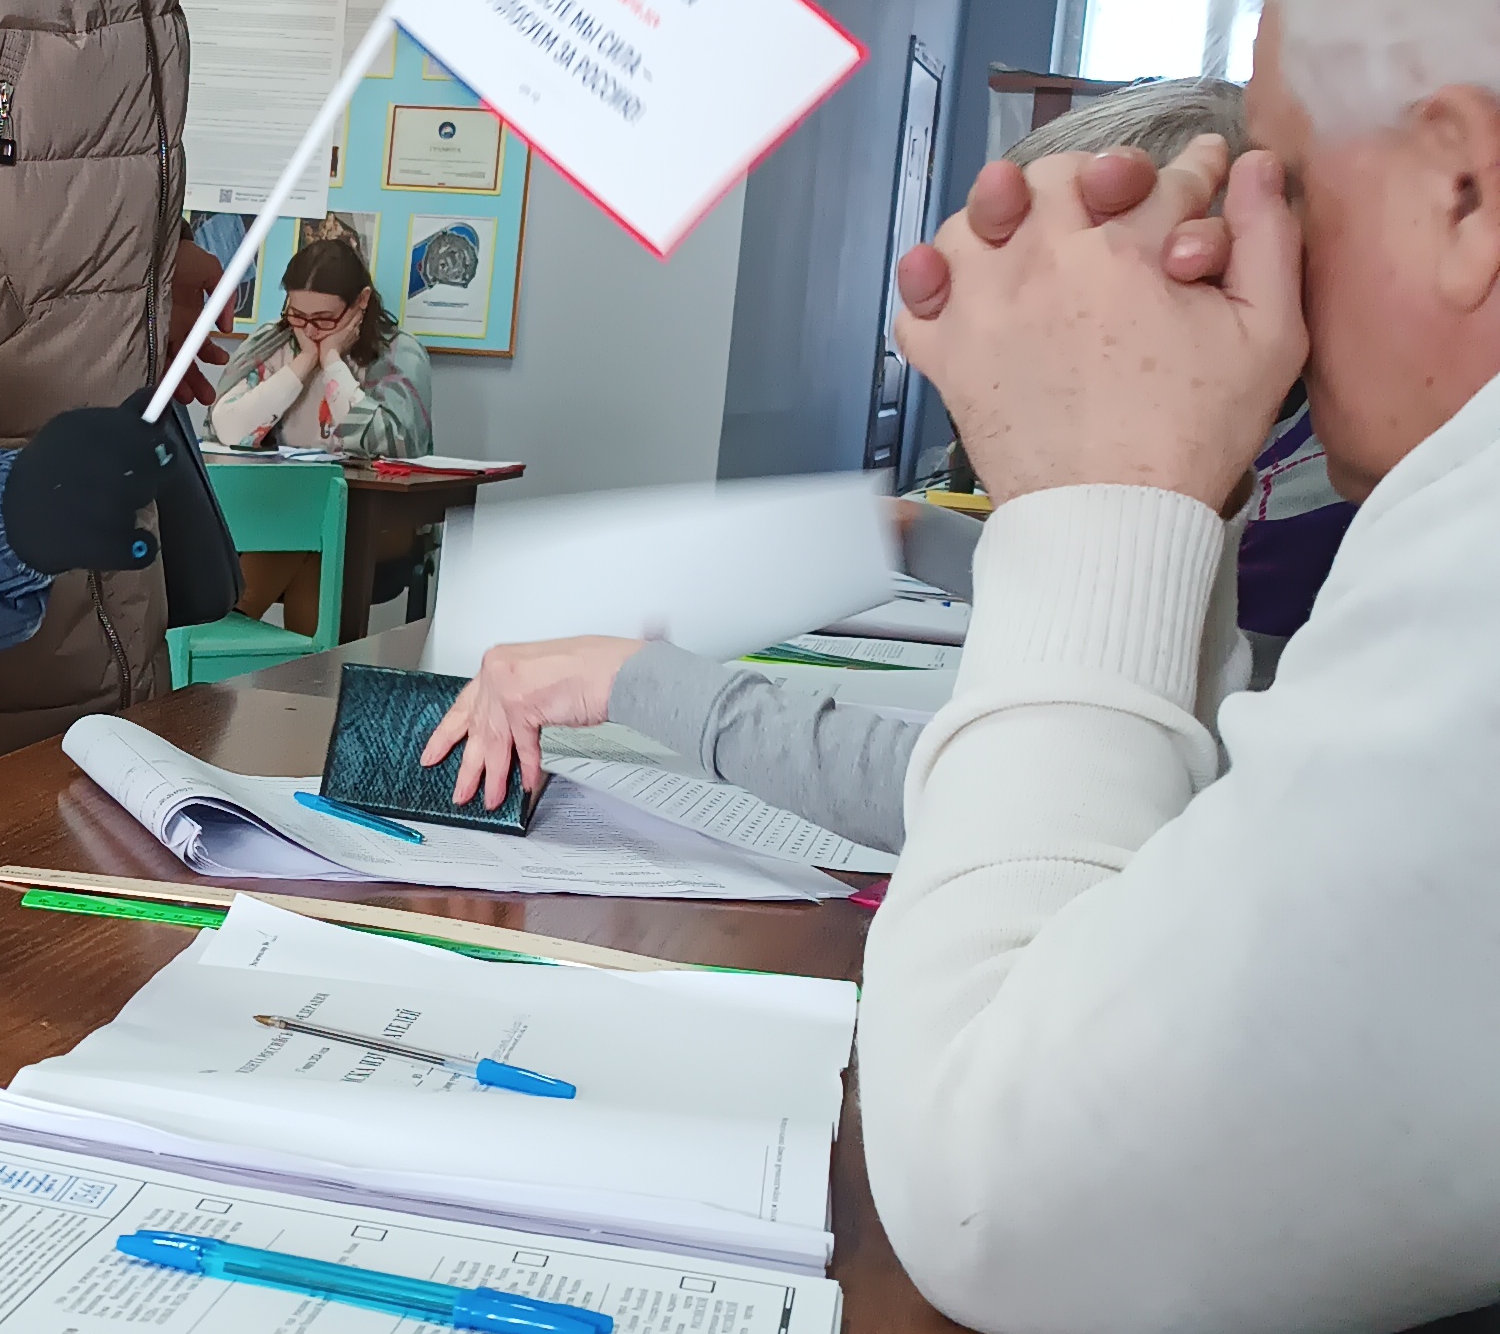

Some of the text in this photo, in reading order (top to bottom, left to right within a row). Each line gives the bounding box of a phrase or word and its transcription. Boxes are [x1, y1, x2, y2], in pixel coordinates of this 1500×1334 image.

[553, 39, 578, 70] ЗА
[568, 7, 604, 45] МЫ
[597, 29, 642, 79] СИЛА
